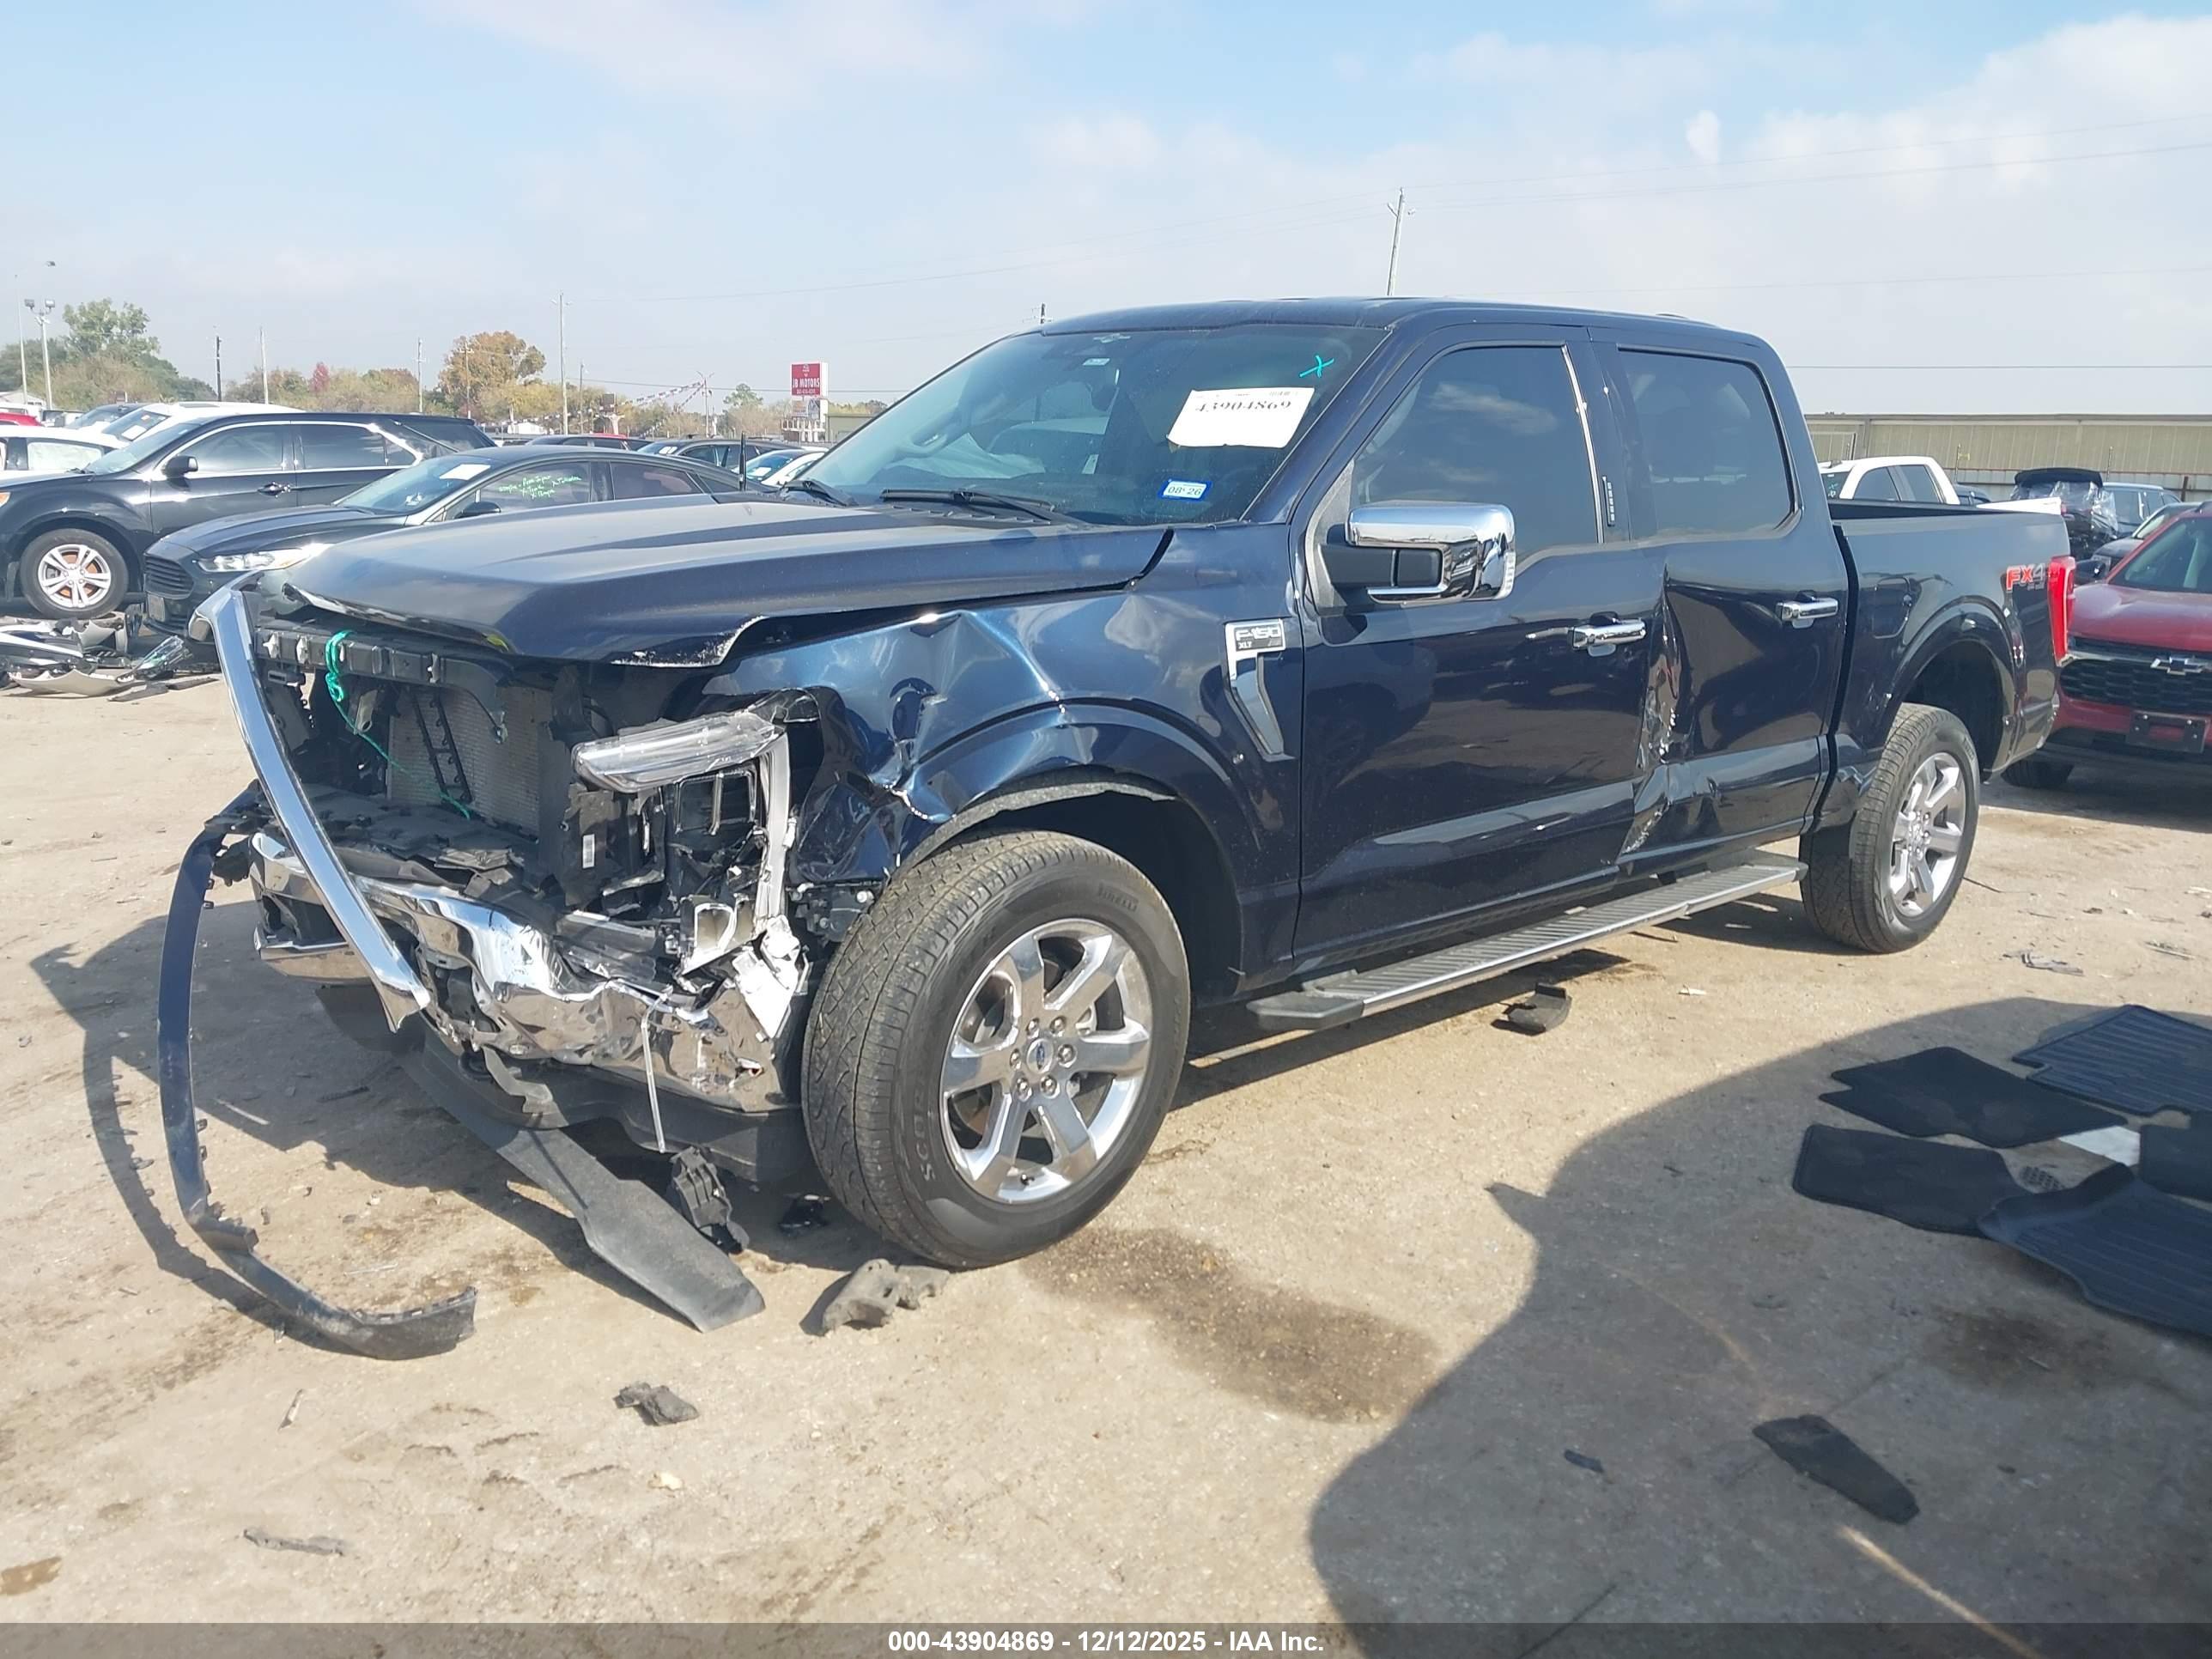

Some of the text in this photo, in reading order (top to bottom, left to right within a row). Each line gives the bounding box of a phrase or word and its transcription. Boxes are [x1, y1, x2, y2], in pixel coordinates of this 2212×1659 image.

[799, 377, 820, 388] MOTORS
[2006, 562, 2045, 591] FX4
[1236, 627, 1282, 641] F-150
[1238, 641, 1252, 649] XLT
